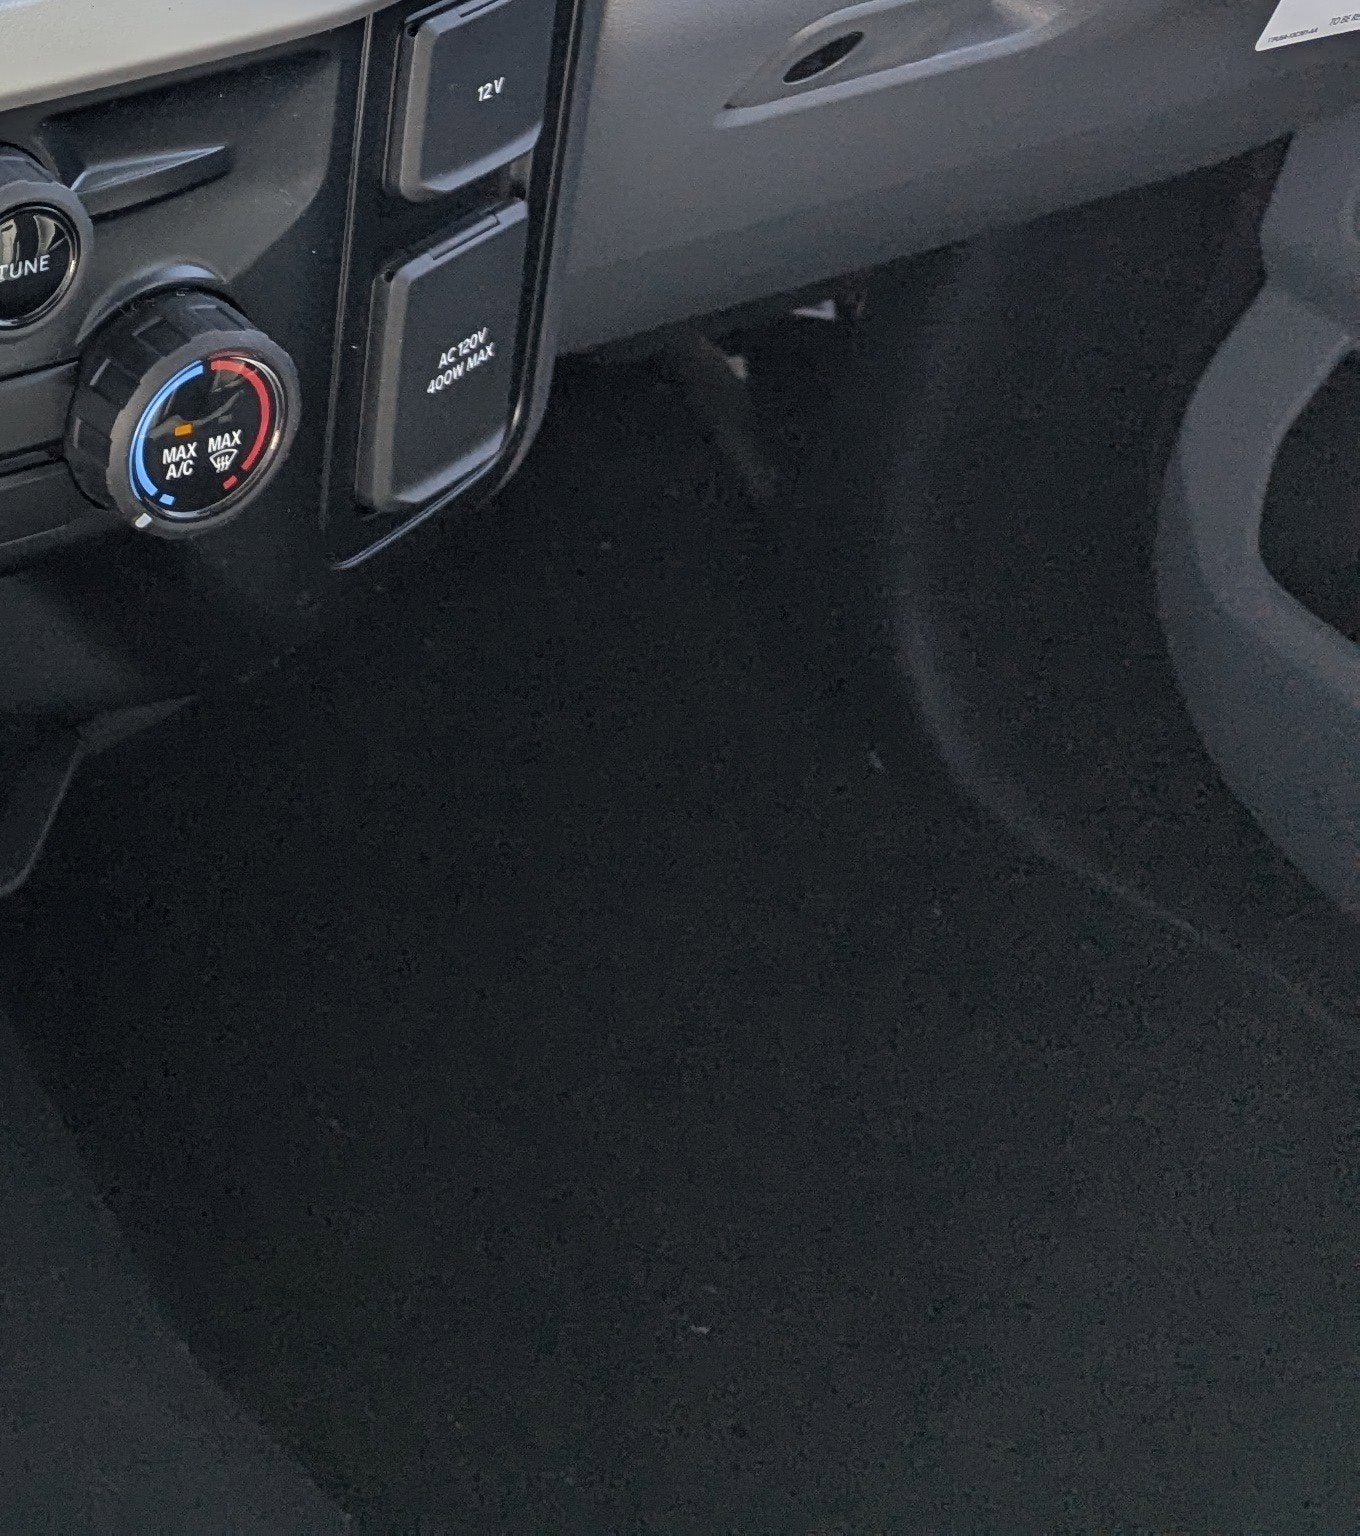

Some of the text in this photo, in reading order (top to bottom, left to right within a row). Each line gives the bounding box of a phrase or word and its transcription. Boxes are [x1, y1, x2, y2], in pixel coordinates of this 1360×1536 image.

[438, 326, 488, 369] AC 120V
[426, 341, 495, 394] 400W MAX
[207, 428, 243, 451] MAX
[162, 440, 198, 464] MAX
[165, 458, 194, 480] A/C
